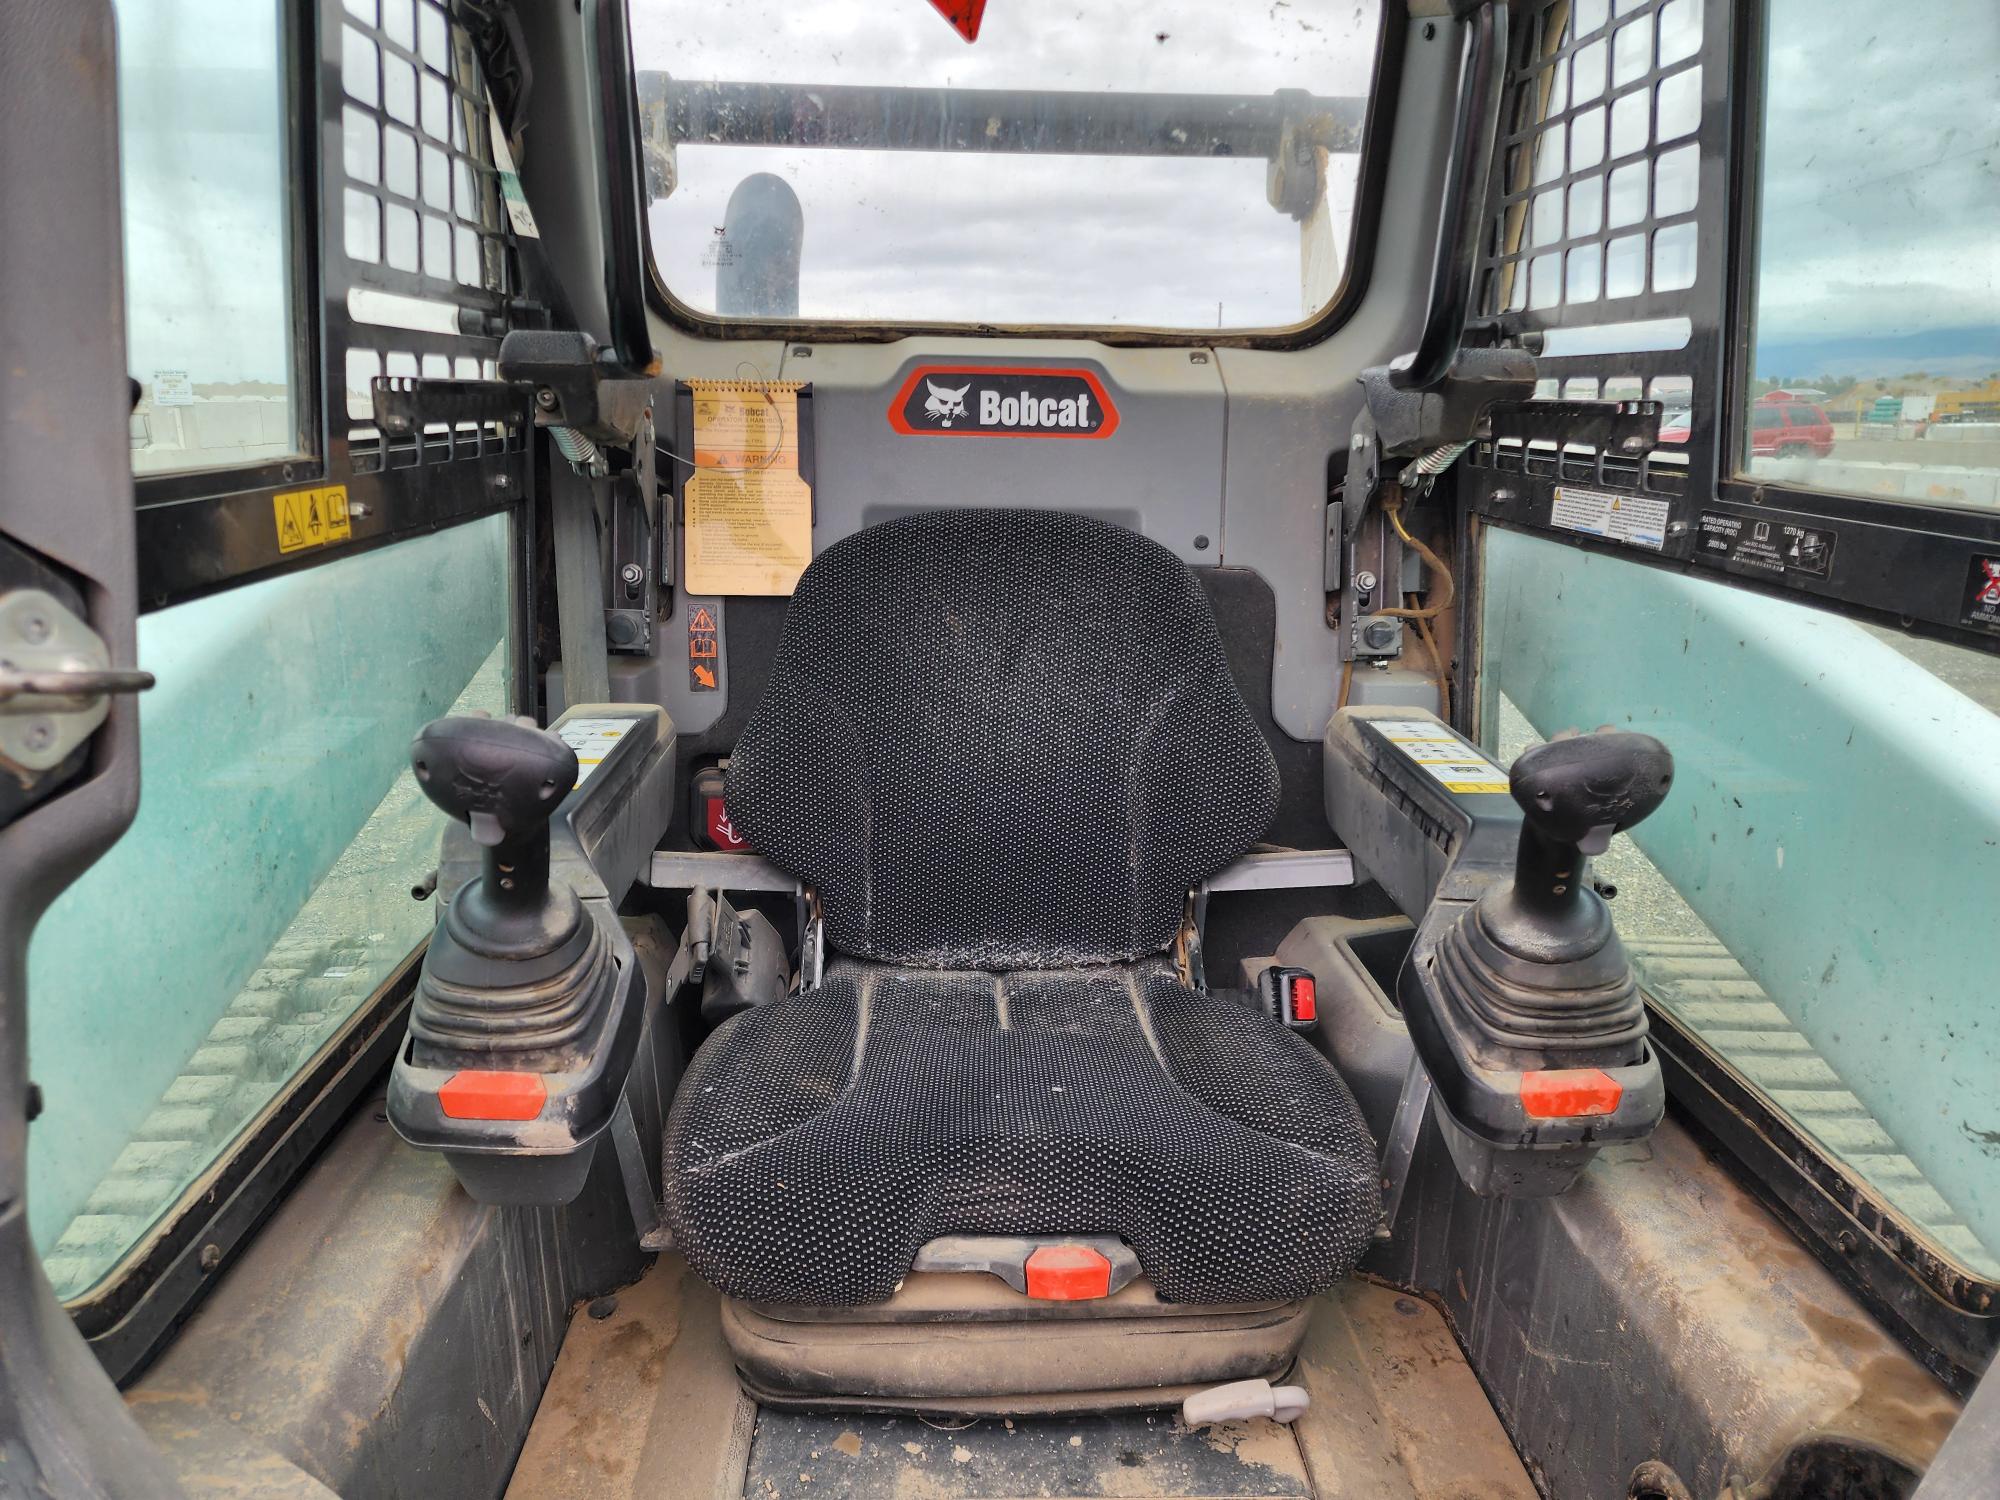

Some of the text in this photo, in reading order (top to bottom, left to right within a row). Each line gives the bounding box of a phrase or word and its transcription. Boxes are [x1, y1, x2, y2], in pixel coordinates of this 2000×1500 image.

[979, 390, 1089, 428] Bobcat
[1784, 526, 1805, 540] 1270 kg
